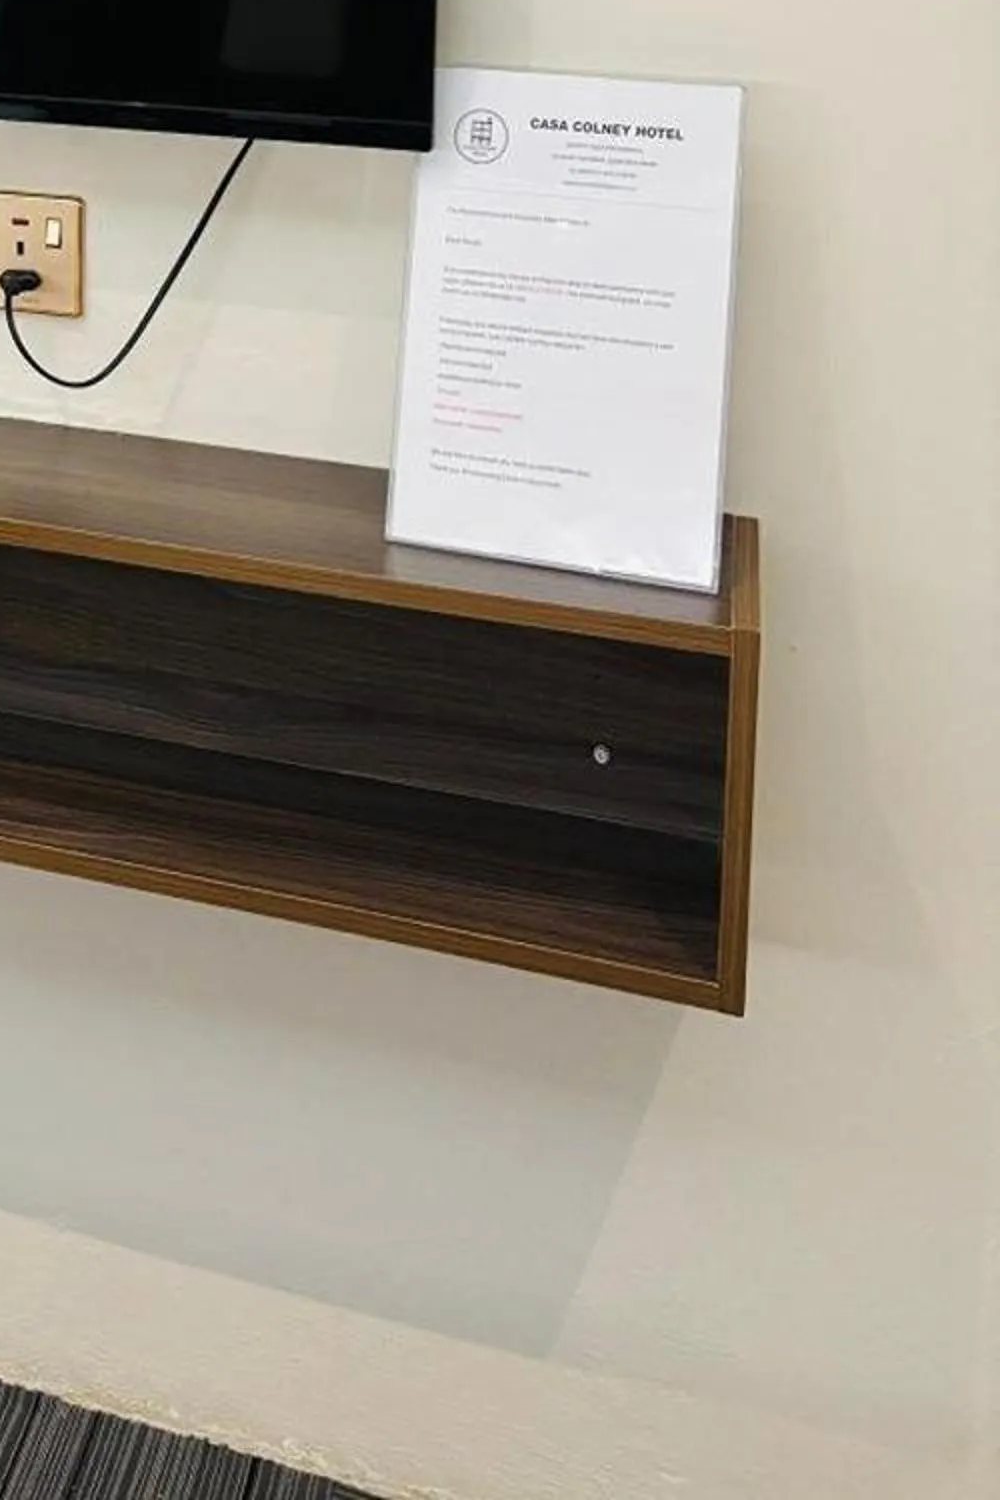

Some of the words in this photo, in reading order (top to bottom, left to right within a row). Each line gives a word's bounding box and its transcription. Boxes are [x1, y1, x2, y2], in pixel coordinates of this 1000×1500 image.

[530, 118, 568, 132] CASA
[572, 120, 631, 137] COLNEY
[635, 125, 684, 141] HOTEL
